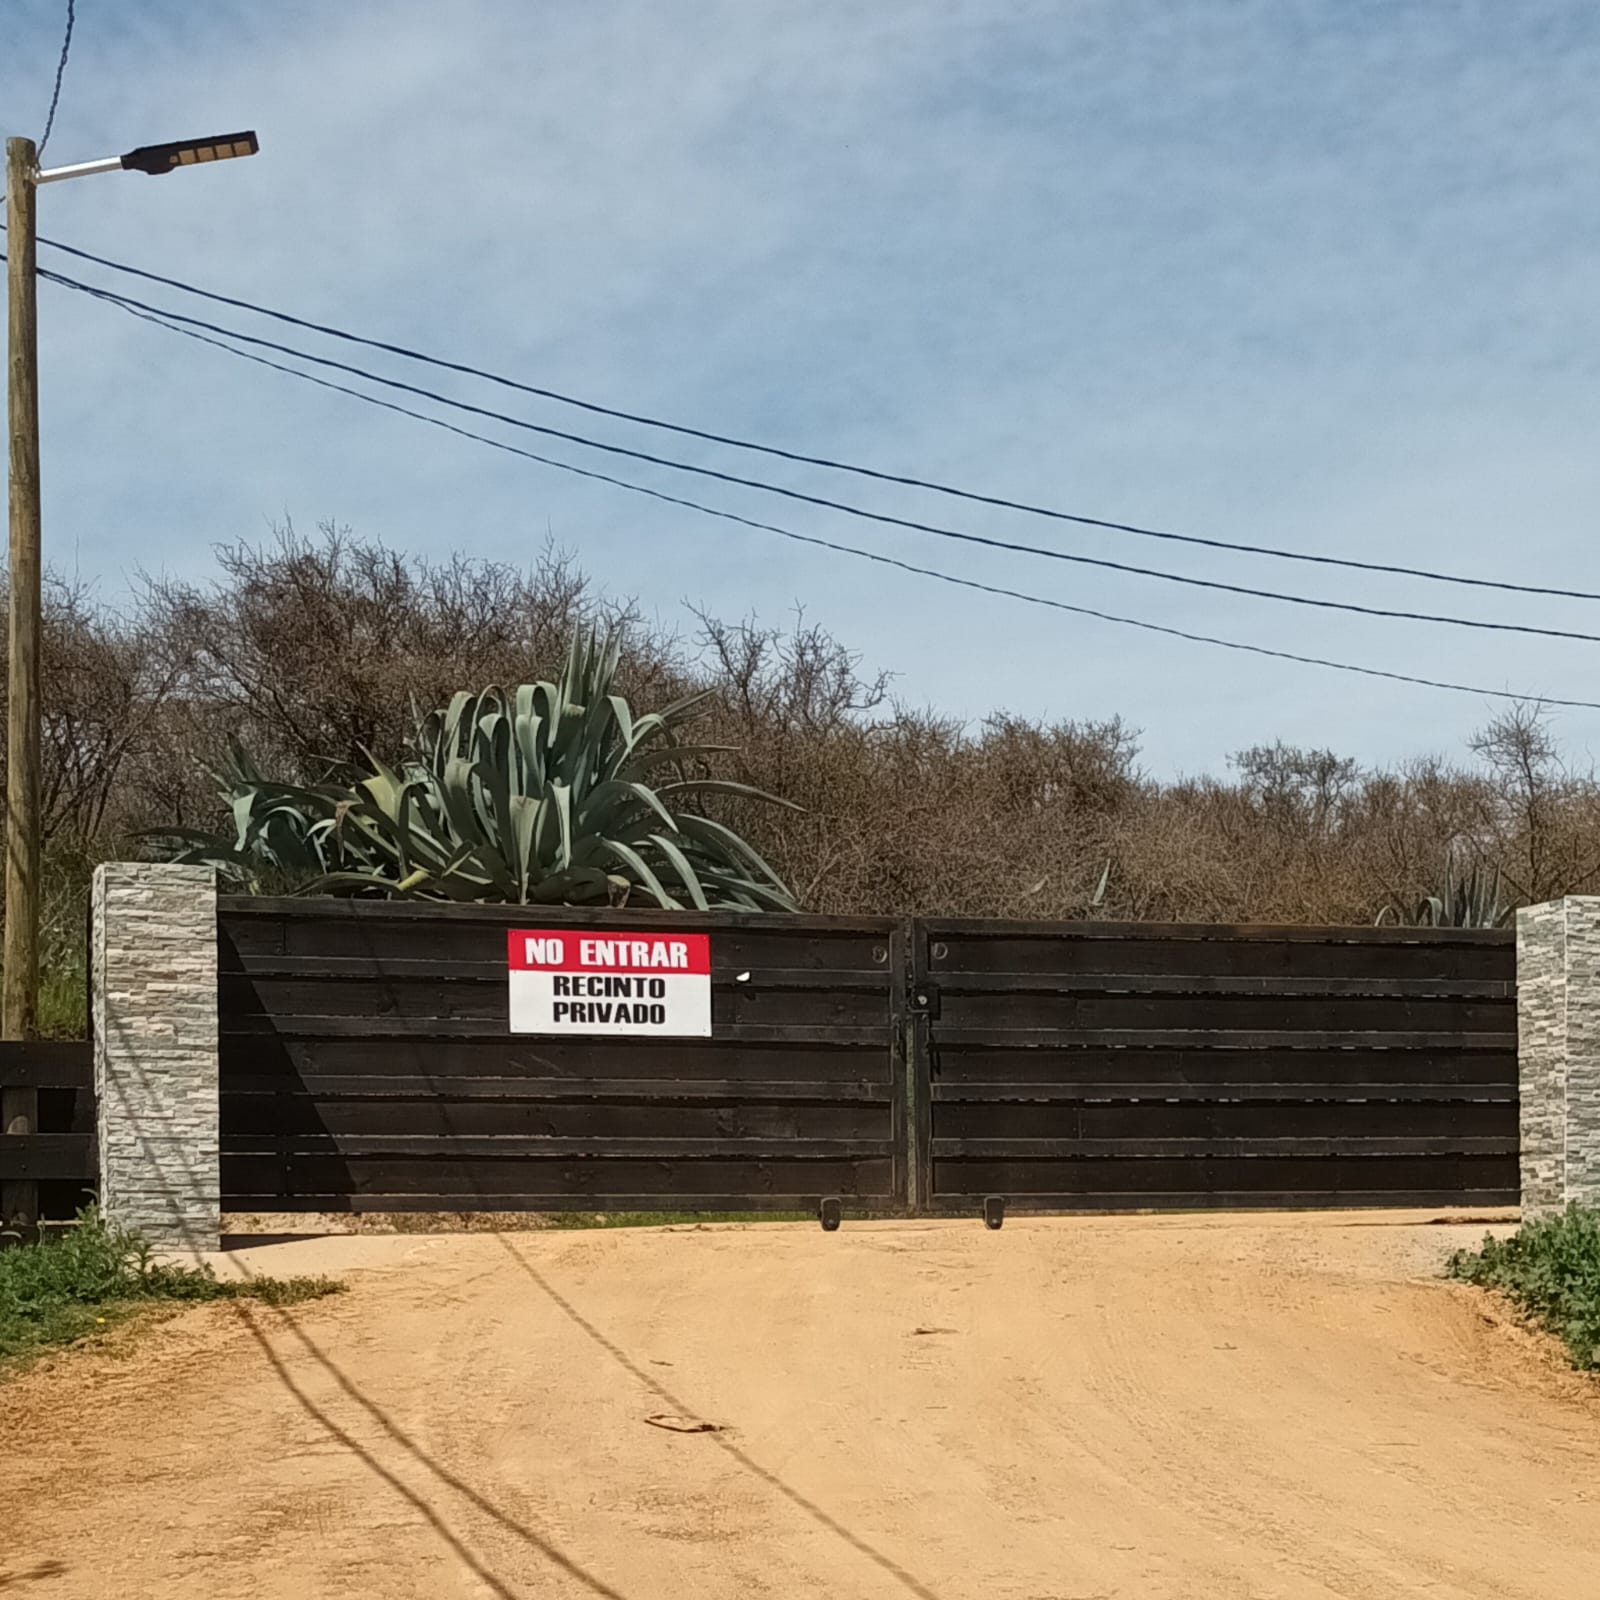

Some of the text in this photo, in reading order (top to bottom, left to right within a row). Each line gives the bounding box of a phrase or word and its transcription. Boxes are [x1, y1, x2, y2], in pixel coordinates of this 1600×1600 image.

[525, 938, 688, 968] NO ENTRAR
[553, 976, 666, 999] RECINTO
[553, 1002, 666, 1024] PRIVADO
